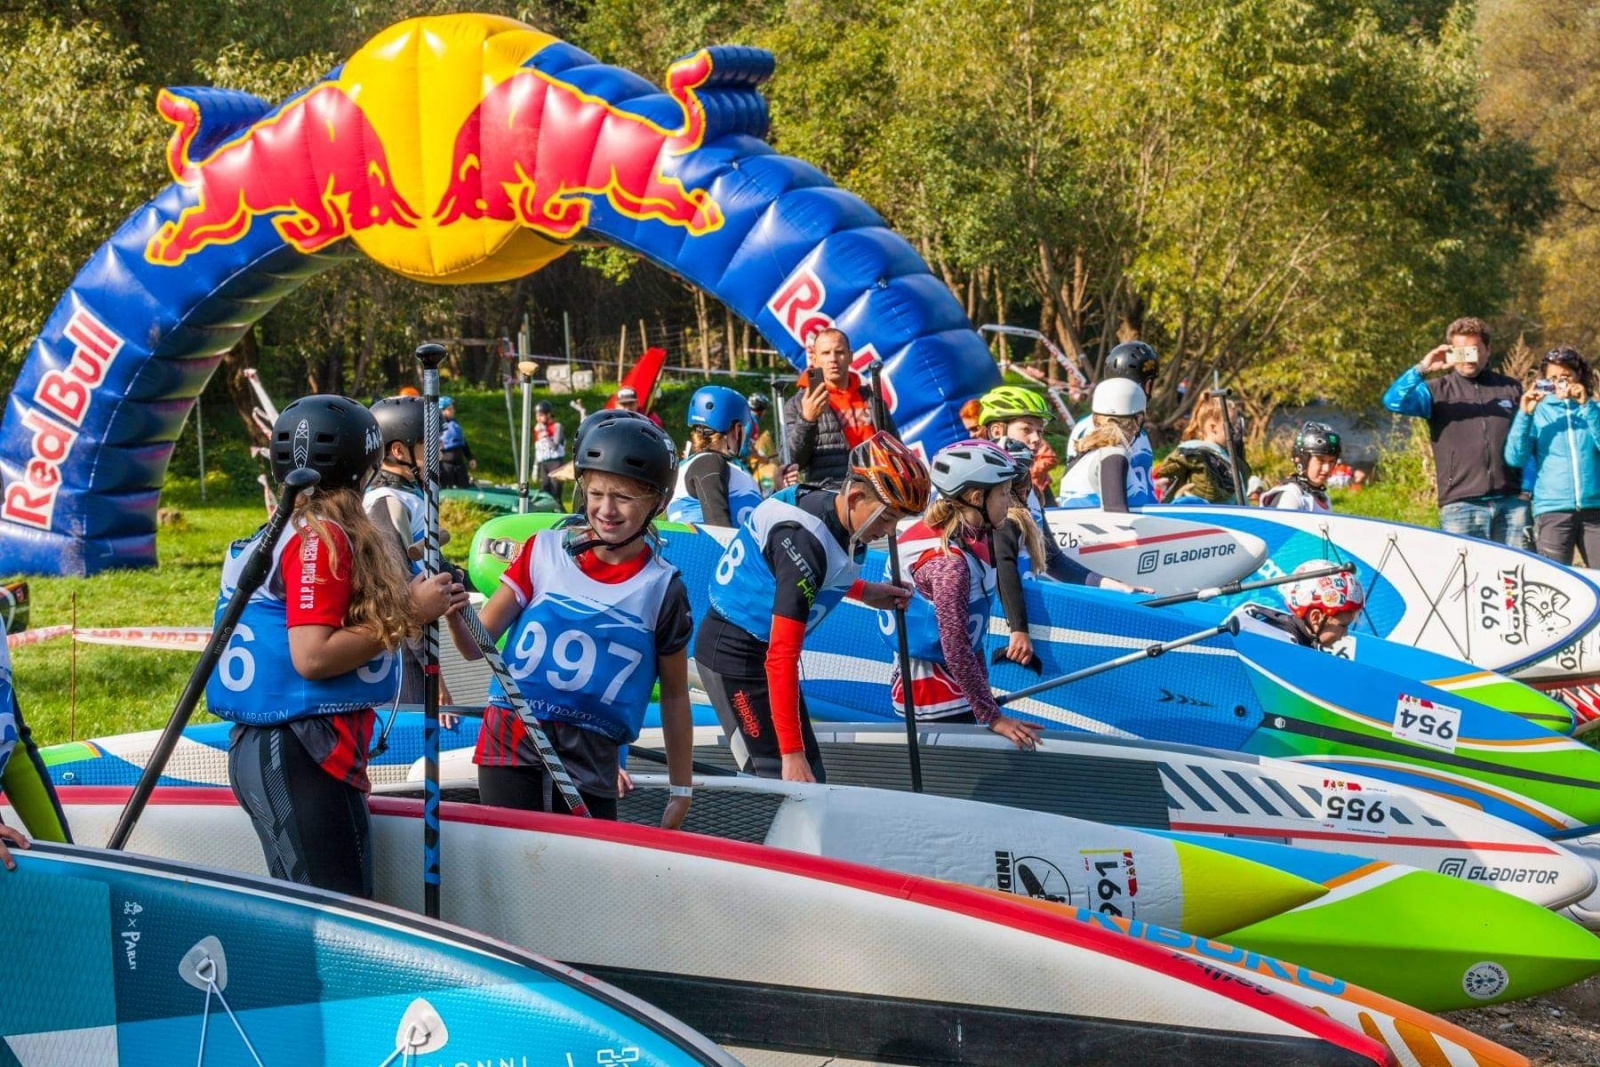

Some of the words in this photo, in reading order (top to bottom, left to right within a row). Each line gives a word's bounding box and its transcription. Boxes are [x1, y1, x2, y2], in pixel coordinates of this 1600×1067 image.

[34, 307, 125, 427] Bull
[2, 408, 78, 529] Red
[1163, 543, 1236, 565] GLADIATOR
[300, 586, 315, 609] S.U.P.
[1481, 586, 1500, 629] 979
[507, 620, 643, 706] 997
[733, 689, 760, 738] TRIBORD
[1400, 709, 1453, 740] 954
[1327, 796, 1385, 824] 955
[1467, 866, 1559, 885] GLADIATOR
